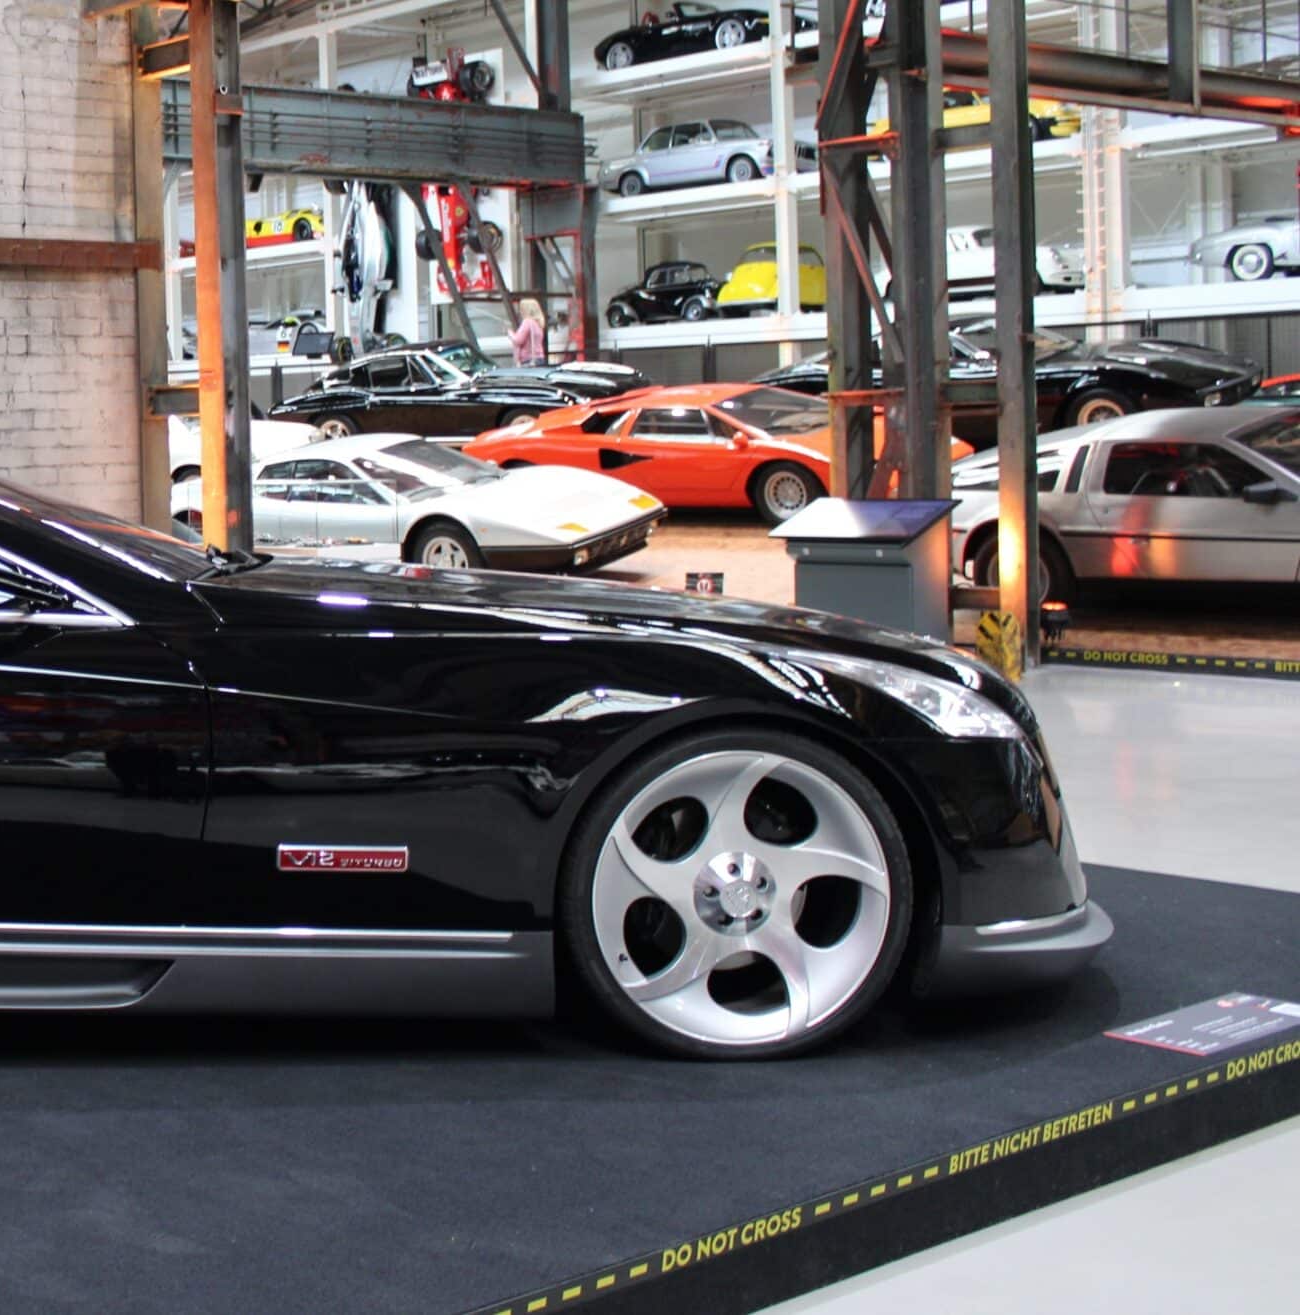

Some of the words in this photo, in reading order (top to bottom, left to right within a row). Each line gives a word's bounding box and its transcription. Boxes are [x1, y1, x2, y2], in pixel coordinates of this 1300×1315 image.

[1084, 650, 1100, 661] DO
[1104, 651, 1127, 662] NOT
[1130, 652, 1168, 665] CROSS
[283, 851, 334, 866] V12
[1226, 1058, 1245, 1080] DO
[1248, 1048, 1274, 1073] NOT
[949, 1143, 990, 1175] BITTE
[992, 1126, 1041, 1160] NICHT
[1042, 1101, 1114, 1143] BETRETEN
[662, 1243, 693, 1272] DO
[696, 1228, 738, 1261] NOT
[741, 1207, 802, 1245] CROSS
